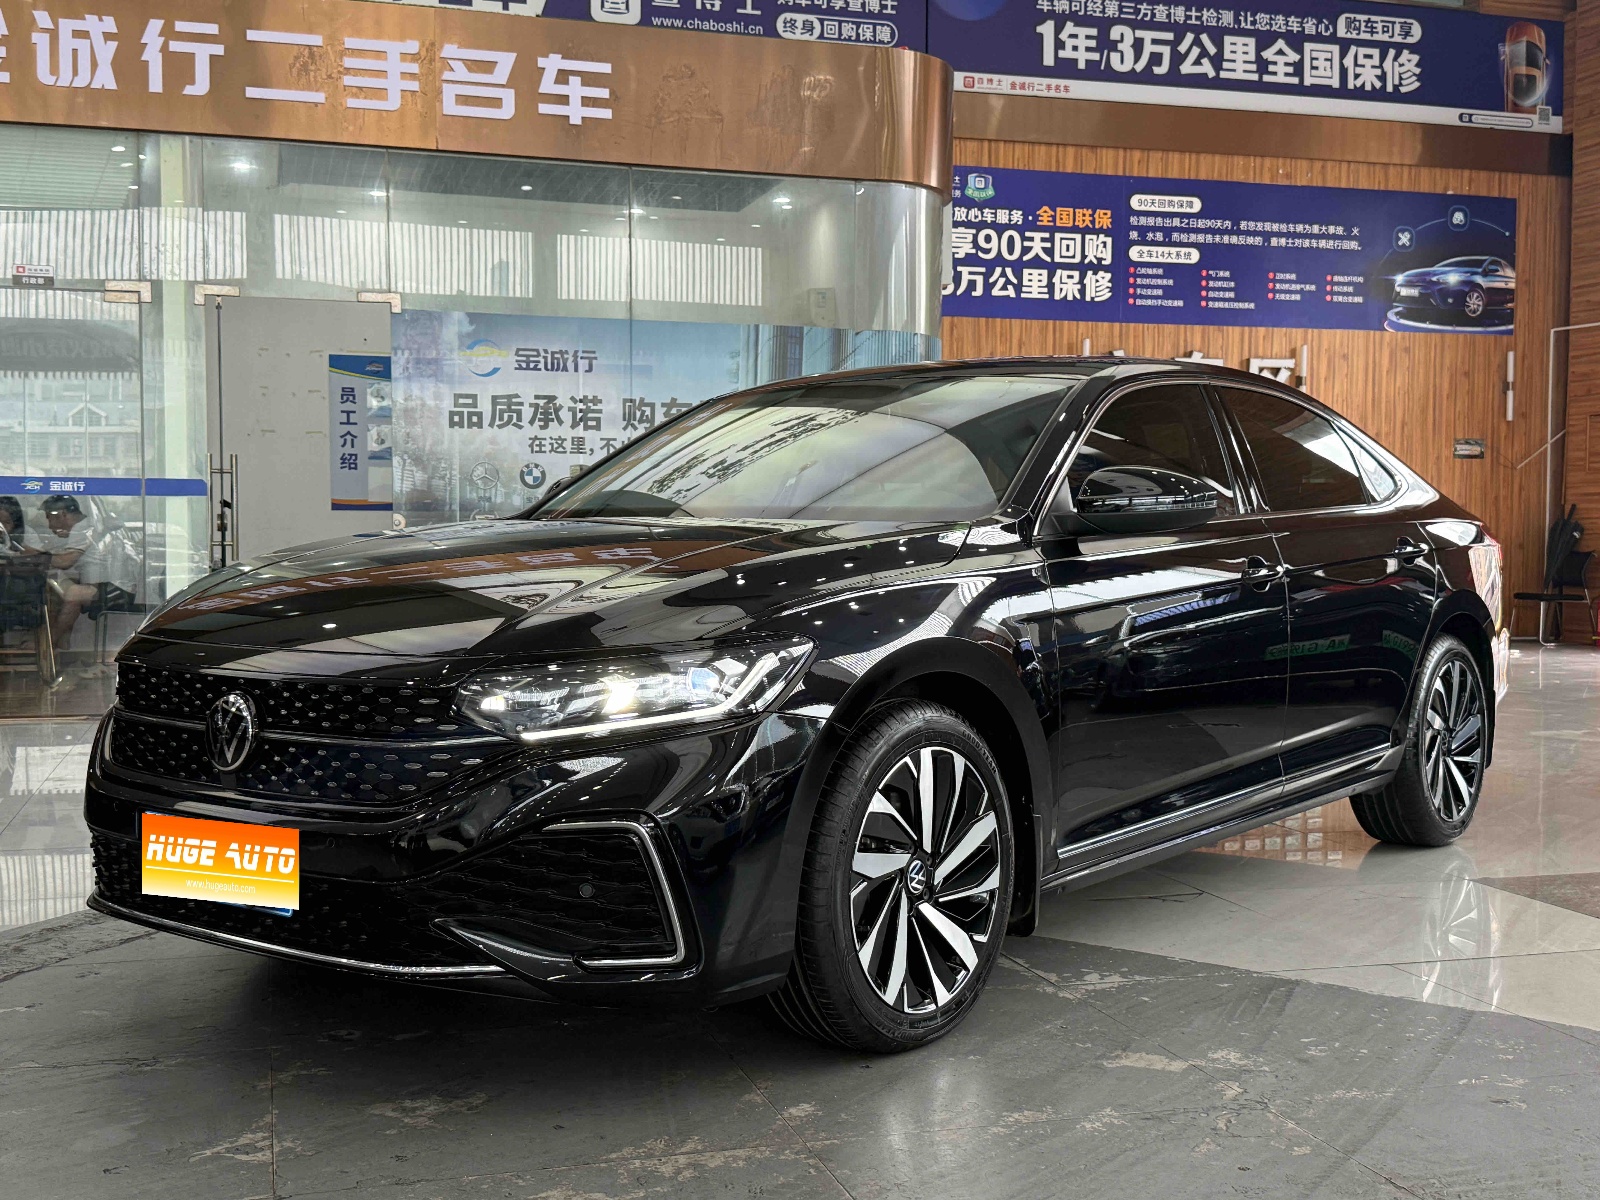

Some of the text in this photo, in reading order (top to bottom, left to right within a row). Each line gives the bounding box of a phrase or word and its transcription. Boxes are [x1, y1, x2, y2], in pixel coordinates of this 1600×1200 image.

[651, 16, 764, 35] www.chaboshi.cn
[1344, 16, 1415, 40] 购车可享
[1009, 81, 1071, 94] 金诚行二手名车
[1137, 198, 1194, 210] 90天回购保障
[1136, 249, 1193, 261] 全车14大系统
[514, 347, 598, 374] 金诚行
[448, 392, 604, 432] 品质承诺
[339, 386, 358, 472] 员工介绍
[49, 481, 86, 492] 金诚行
